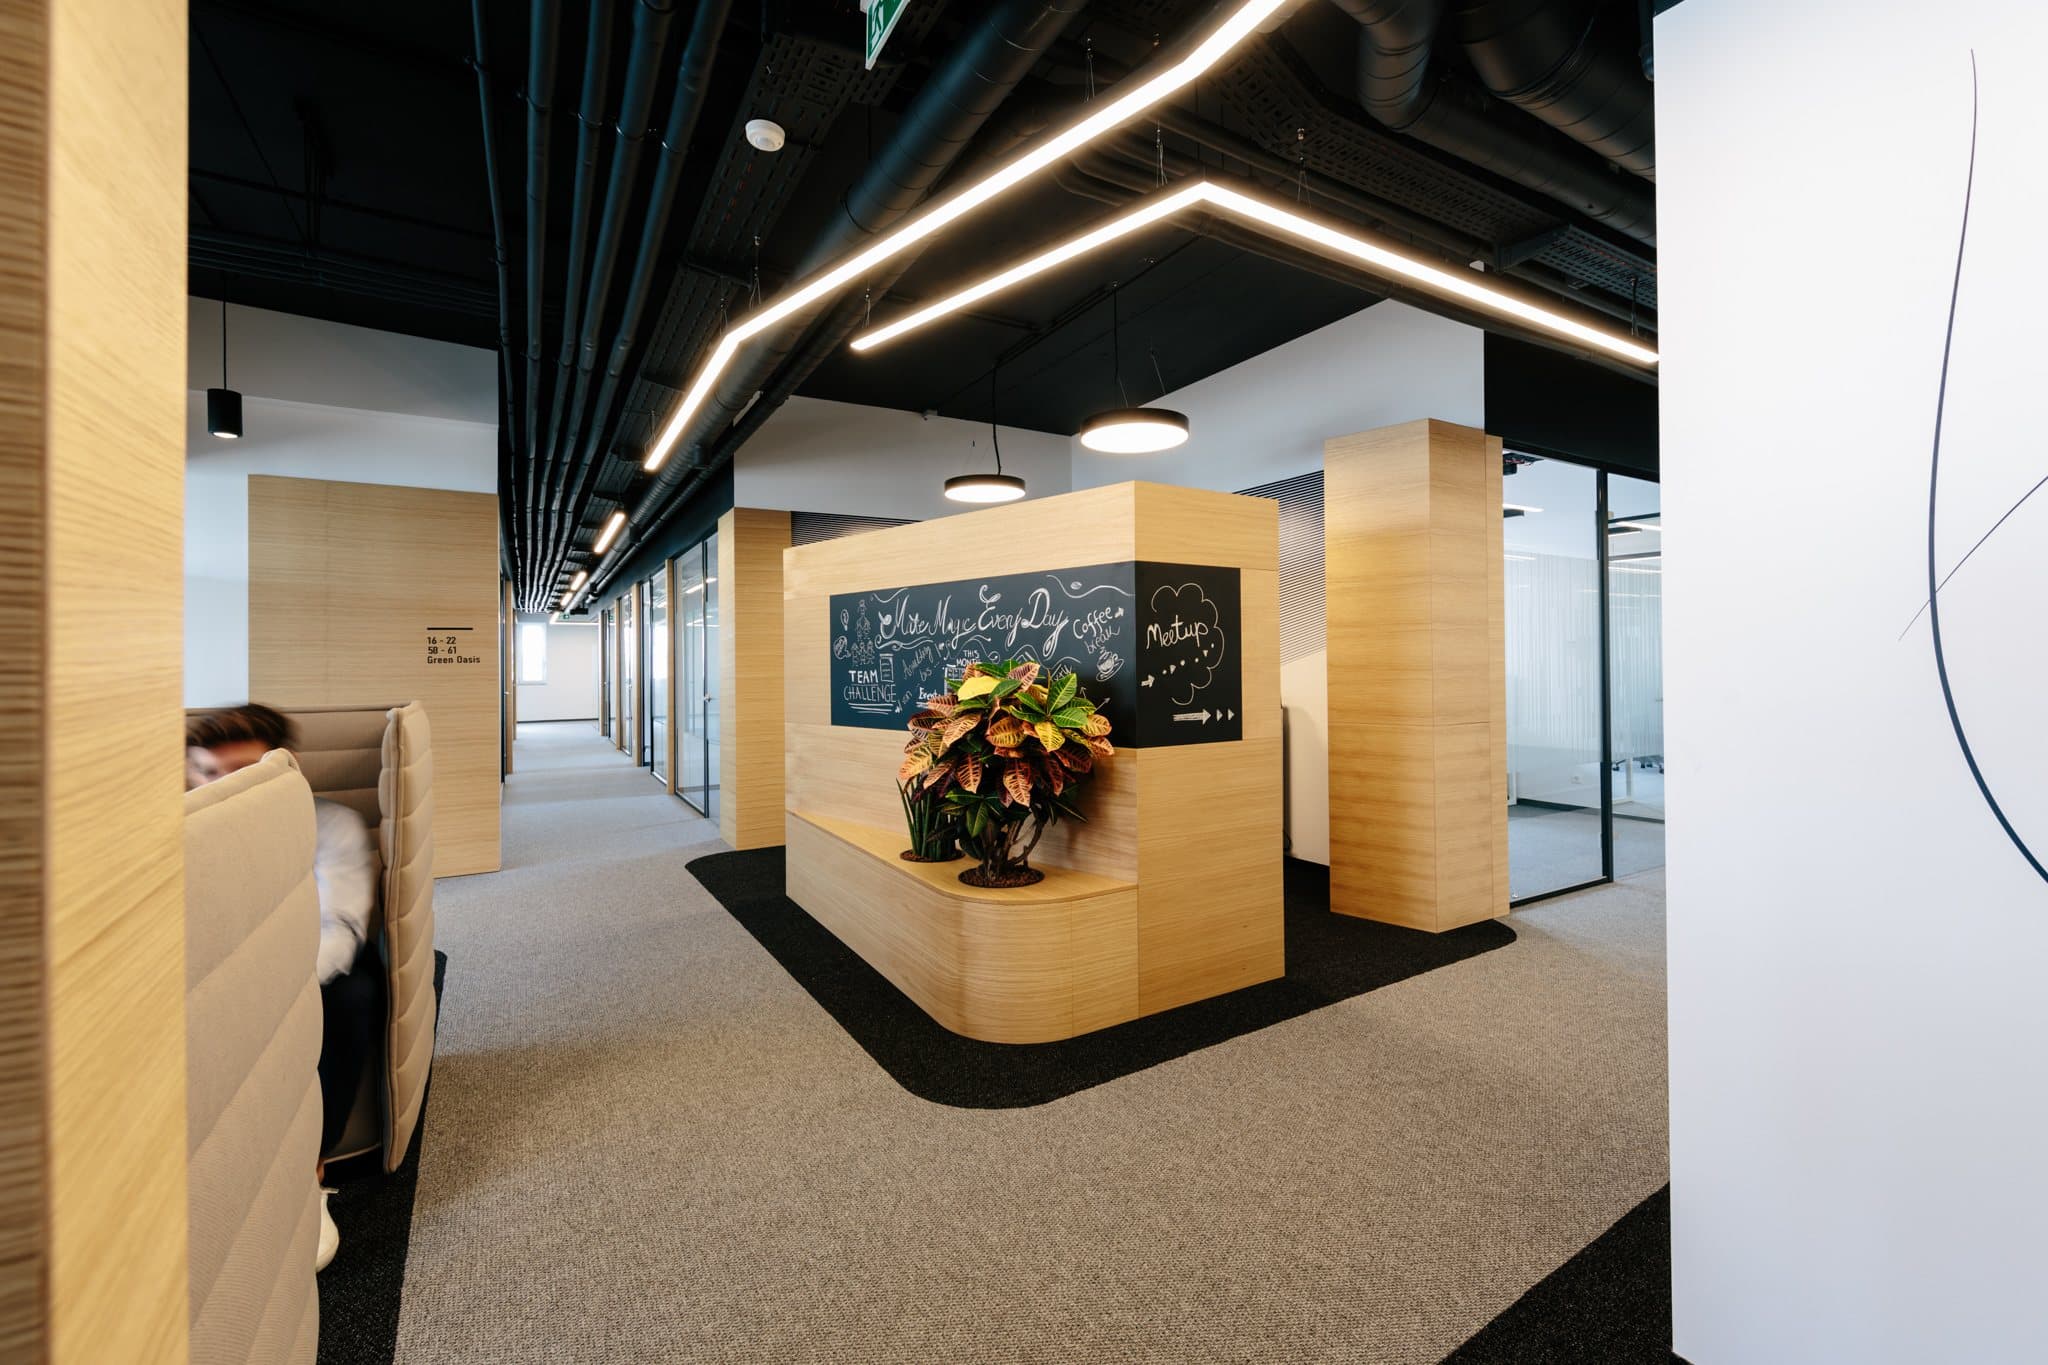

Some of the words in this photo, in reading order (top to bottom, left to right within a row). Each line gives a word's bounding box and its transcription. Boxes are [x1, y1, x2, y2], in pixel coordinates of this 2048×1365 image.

[977, 584, 1023, 650] Every
[1020, 587, 1070, 659] Day
[1073, 607, 1113, 639] Coffee
[1146, 614, 1209, 649] Meetup
[427, 636, 437, 645] 16
[446, 636, 457, 645] 22
[1084, 625, 1120, 654] break
[447, 646, 457, 655] 61
[962, 649, 980, 659] THIS
[427, 655, 454, 664] Green
[456, 655, 481, 664] Oasis
[956, 658, 982, 672] MONT
[848, 669, 879, 684] TEAM
[843, 684, 897, 703] CHALLENGE
